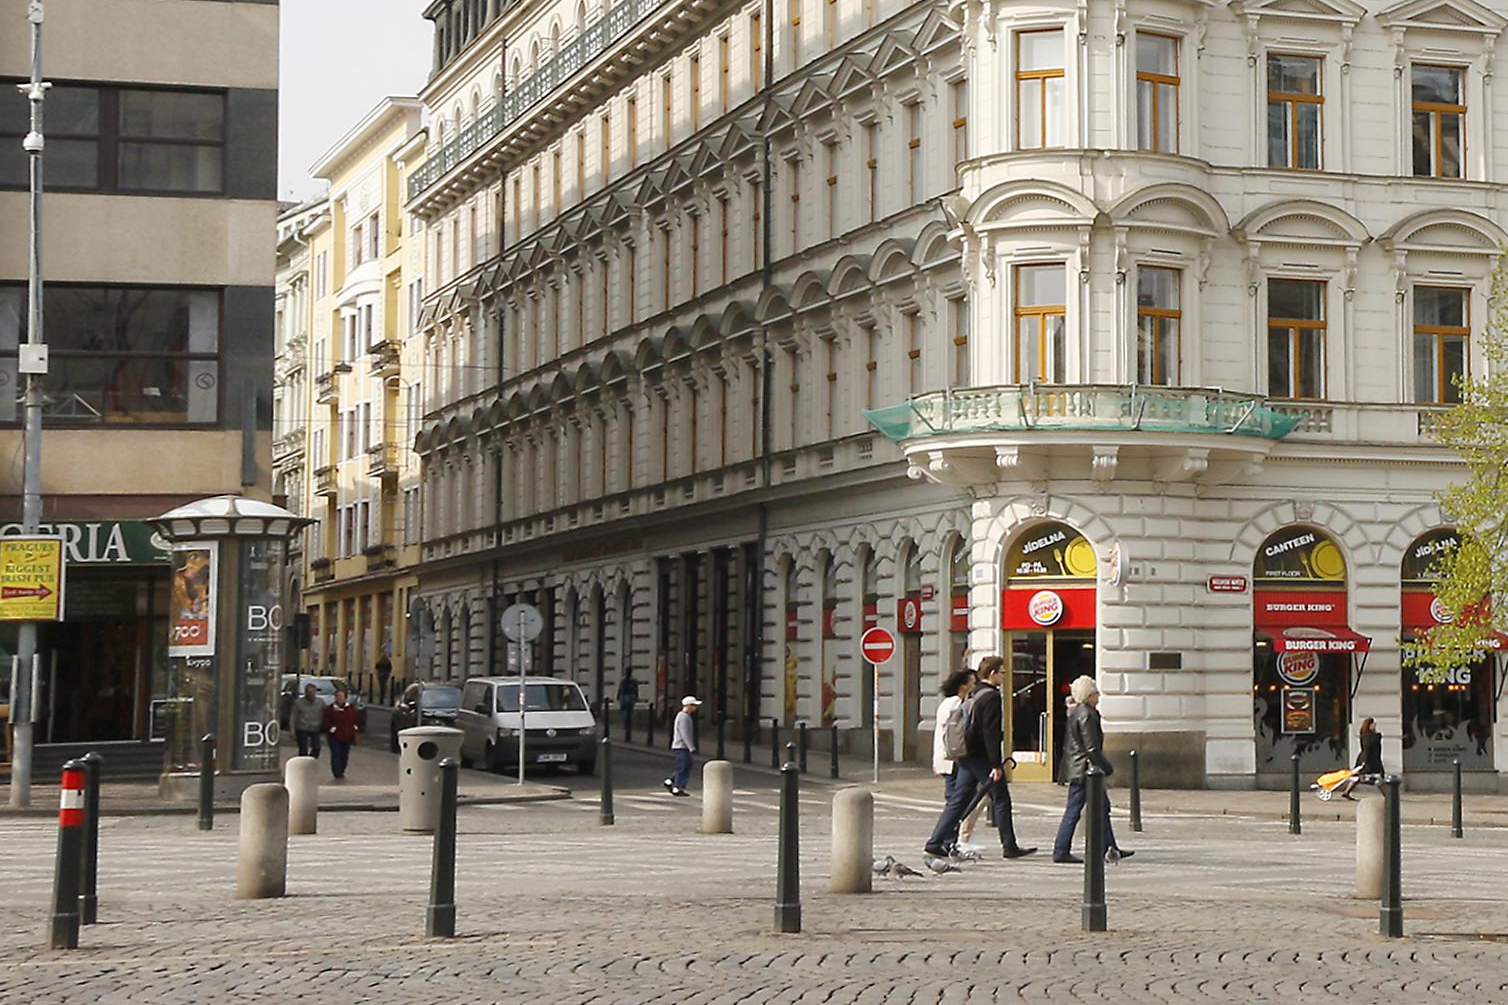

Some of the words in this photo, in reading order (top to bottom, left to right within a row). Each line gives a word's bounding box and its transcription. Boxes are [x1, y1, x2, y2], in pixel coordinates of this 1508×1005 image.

[1022, 531, 1066, 554] JÍDELNA
[1265, 533, 1315, 556] CANTEEN
[1415, 537, 1457, 558] JÍDLNA
[1034, 603, 1059, 616] KING
[1285, 640, 1327, 650] BURGER
[1328, 640, 1355, 650] KING
[1284, 659, 1316, 675] KING
